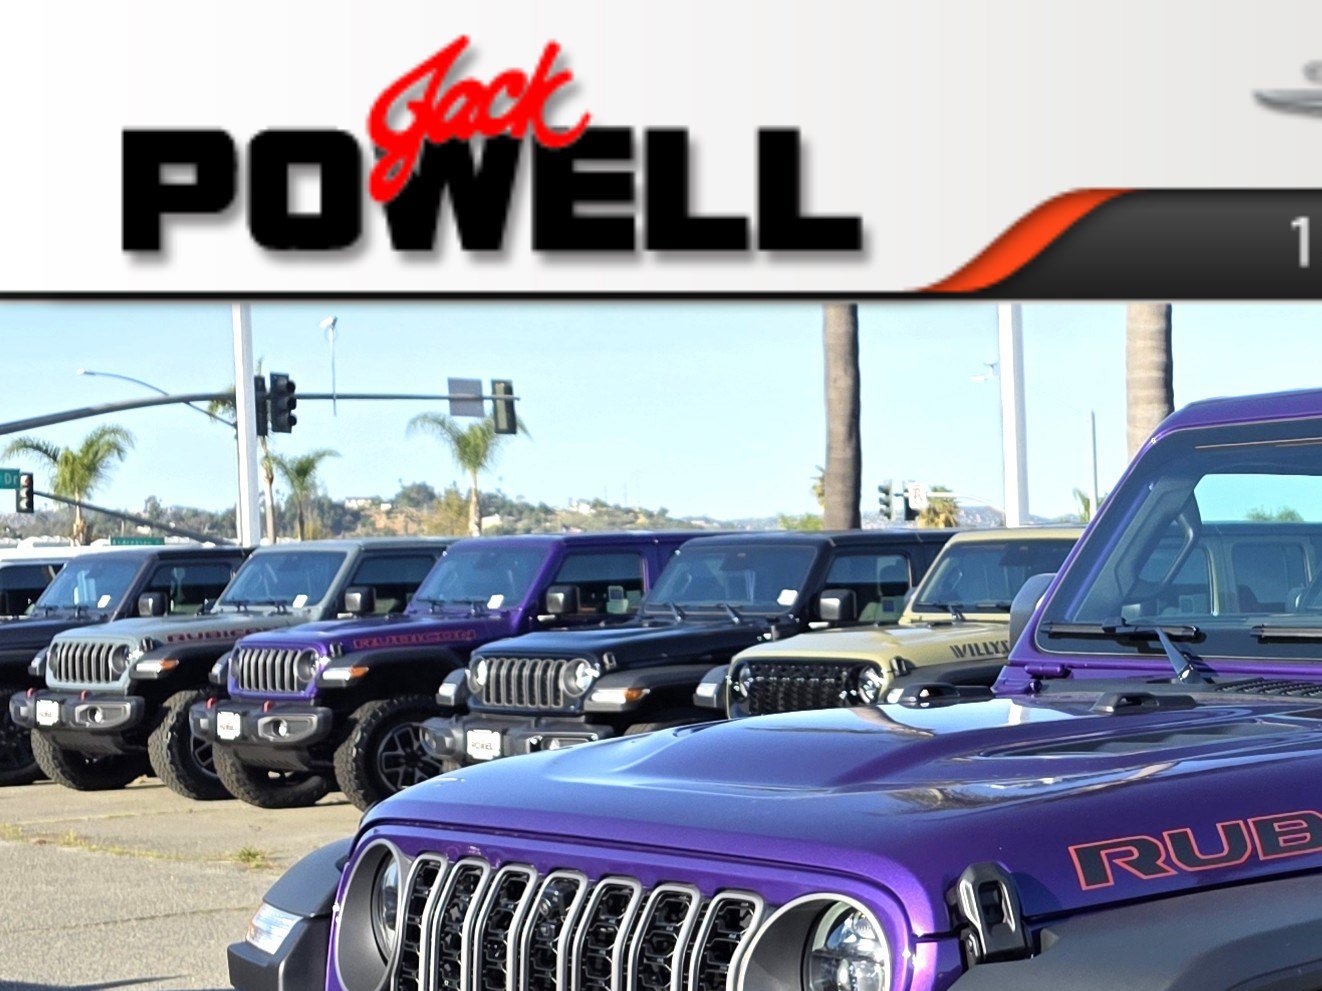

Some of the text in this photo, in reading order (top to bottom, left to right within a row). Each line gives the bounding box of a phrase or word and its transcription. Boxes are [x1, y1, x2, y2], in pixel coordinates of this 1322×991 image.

[4, 472, 18, 485] Dr
[167, 628, 275, 645] RUBIC
[949, 640, 1010, 658] WILLYS
